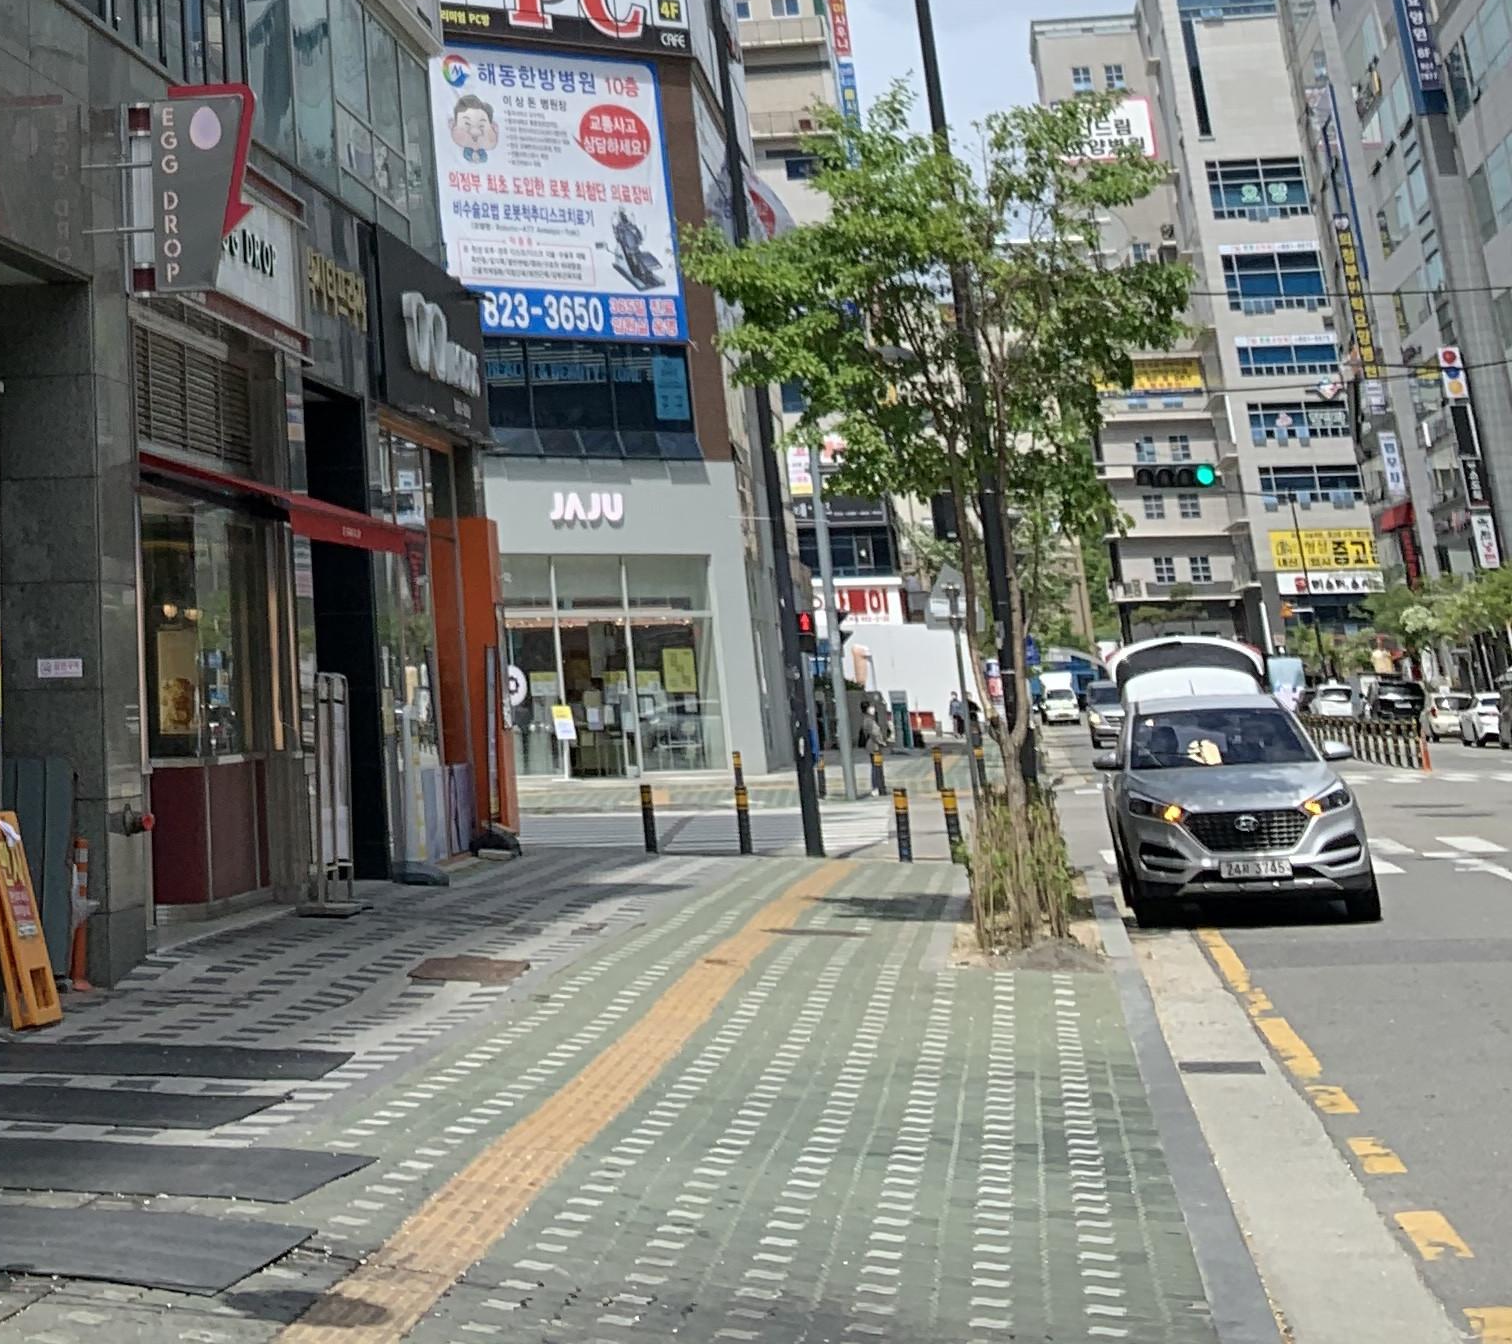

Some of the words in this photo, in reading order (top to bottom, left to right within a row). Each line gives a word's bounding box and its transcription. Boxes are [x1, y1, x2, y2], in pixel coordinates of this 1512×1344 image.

[659, 1, 680, 20] 4F
[660, 32, 686, 49] CAFE
[477, 62, 597, 96] 해동한방병원
[604, 75, 641, 98] 10층
[161, 107, 178, 174] EGG
[589, 114, 638, 133] 교통사고
[583, 135, 648, 158] 상담하세요!
[448, 170, 481, 194] 의정부
[487, 175, 510, 194] 최초
[513, 176, 546, 199] 도입한
[549, 178, 571, 200] 로봇
[610, 183, 654, 205] 의료장비
[163, 191, 182, 283] DROP
[242, 228, 278, 278] DROP
[483, 291, 604, 333] 823-3650
[550, 492, 624, 524] JAJU
